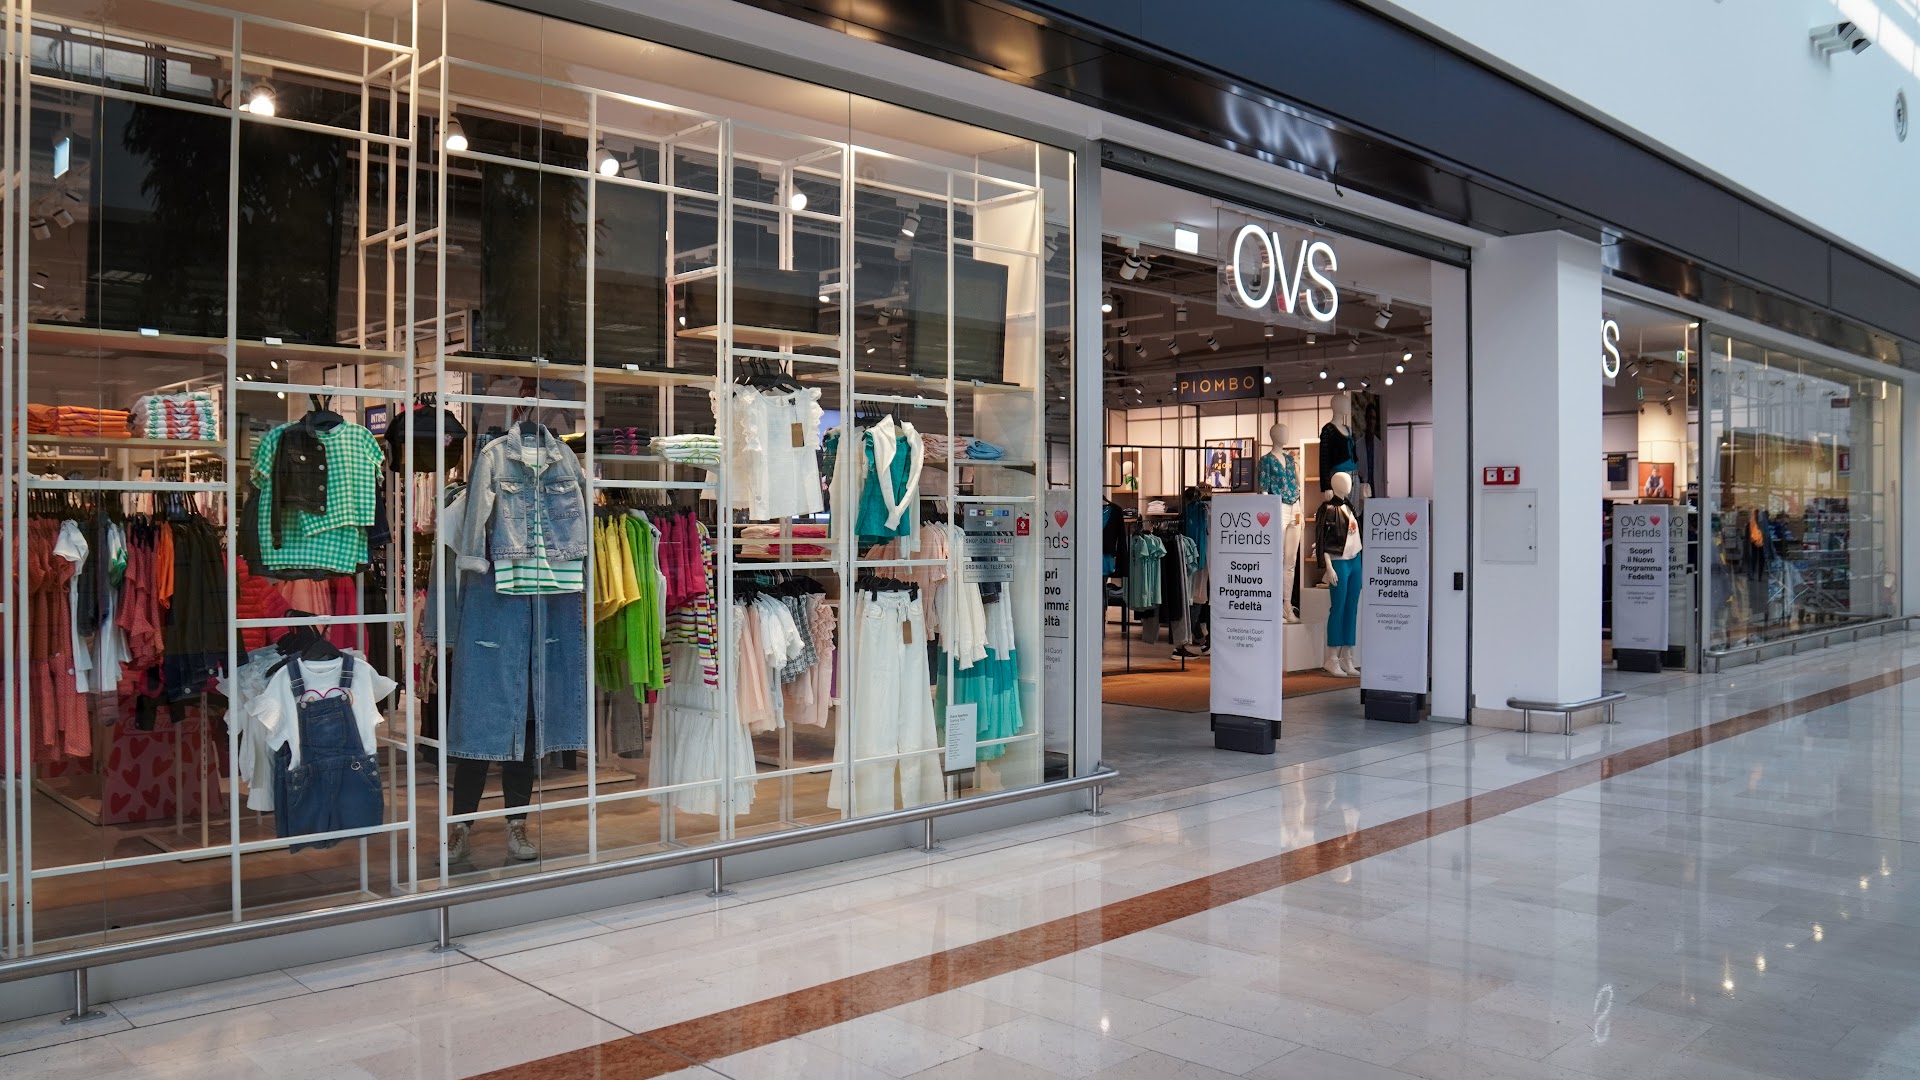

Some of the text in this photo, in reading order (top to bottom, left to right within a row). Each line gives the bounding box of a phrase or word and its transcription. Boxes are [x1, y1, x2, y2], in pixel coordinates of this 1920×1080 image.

[1232, 224, 1339, 322] OVS
[1180, 375, 1255, 394] PIOMBO
[1220, 511, 1252, 529] OVS
[1371, 512, 1400, 527] OVS
[1620, 515, 1646, 527] OVS
[1220, 530, 1271, 545] Friends
[1371, 528, 1418, 541] Friends
[1621, 527, 1661, 538] Friends
[1629, 547, 1653, 556] Scopri
[1380, 554, 1408, 565] Scopri
[1230, 560, 1260, 573] Scopri
[1377, 566, 1410, 575] il Nuovo
[1620, 564, 1662, 573] Programma
[1227, 574, 1263, 585] il Nuovo
[1369, 577, 1419, 588] Programma
[1219, 586, 1272, 599] Programma
[1228, 600, 1262, 611] Fedeltà
